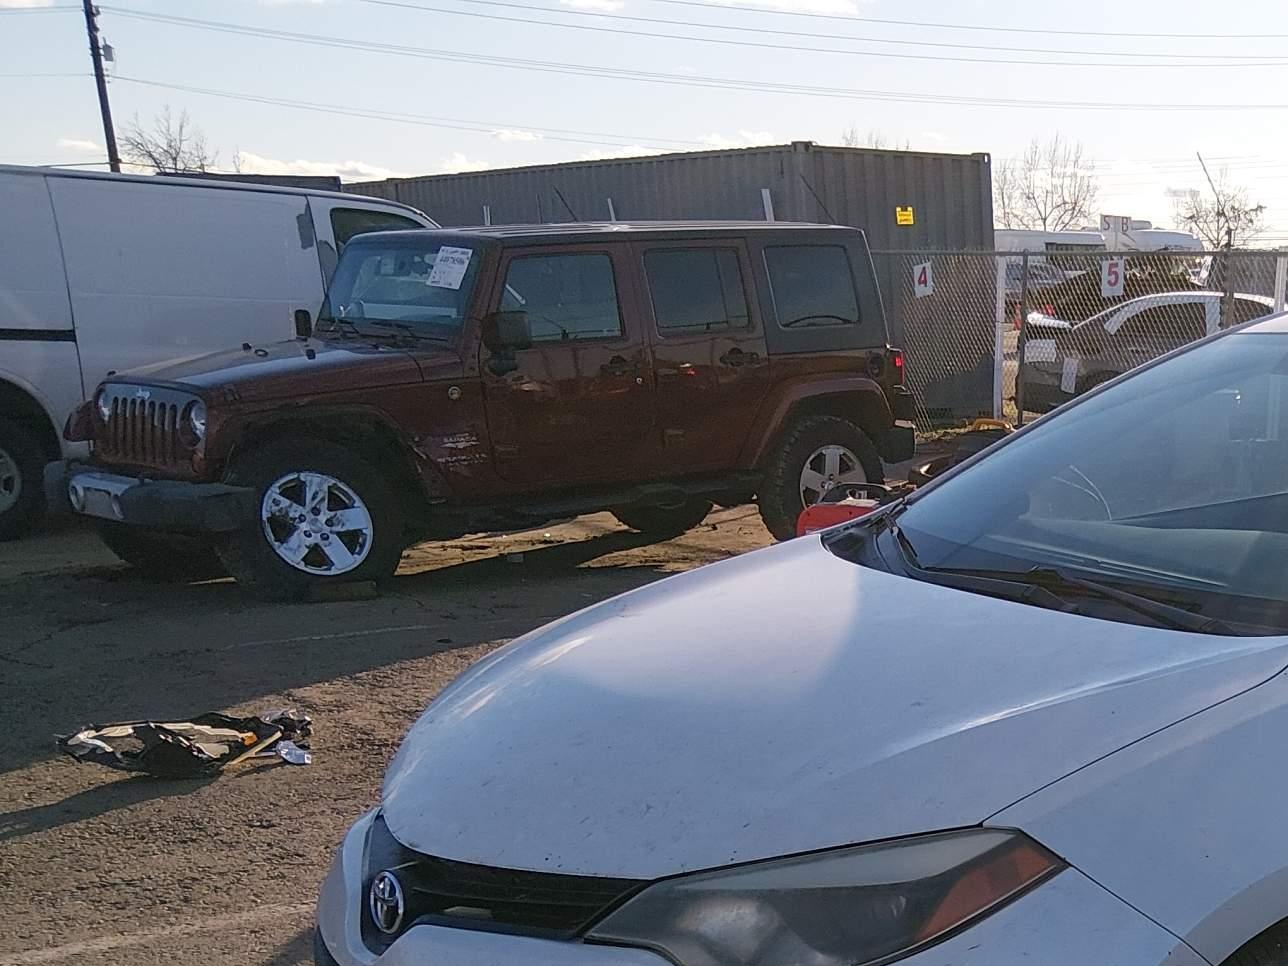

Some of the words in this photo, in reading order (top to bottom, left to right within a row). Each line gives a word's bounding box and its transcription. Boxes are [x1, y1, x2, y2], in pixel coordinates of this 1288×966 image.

[1121, 216, 1129, 232] B
[917, 265, 928, 288] 4
[1106, 262, 1120, 287] 5
